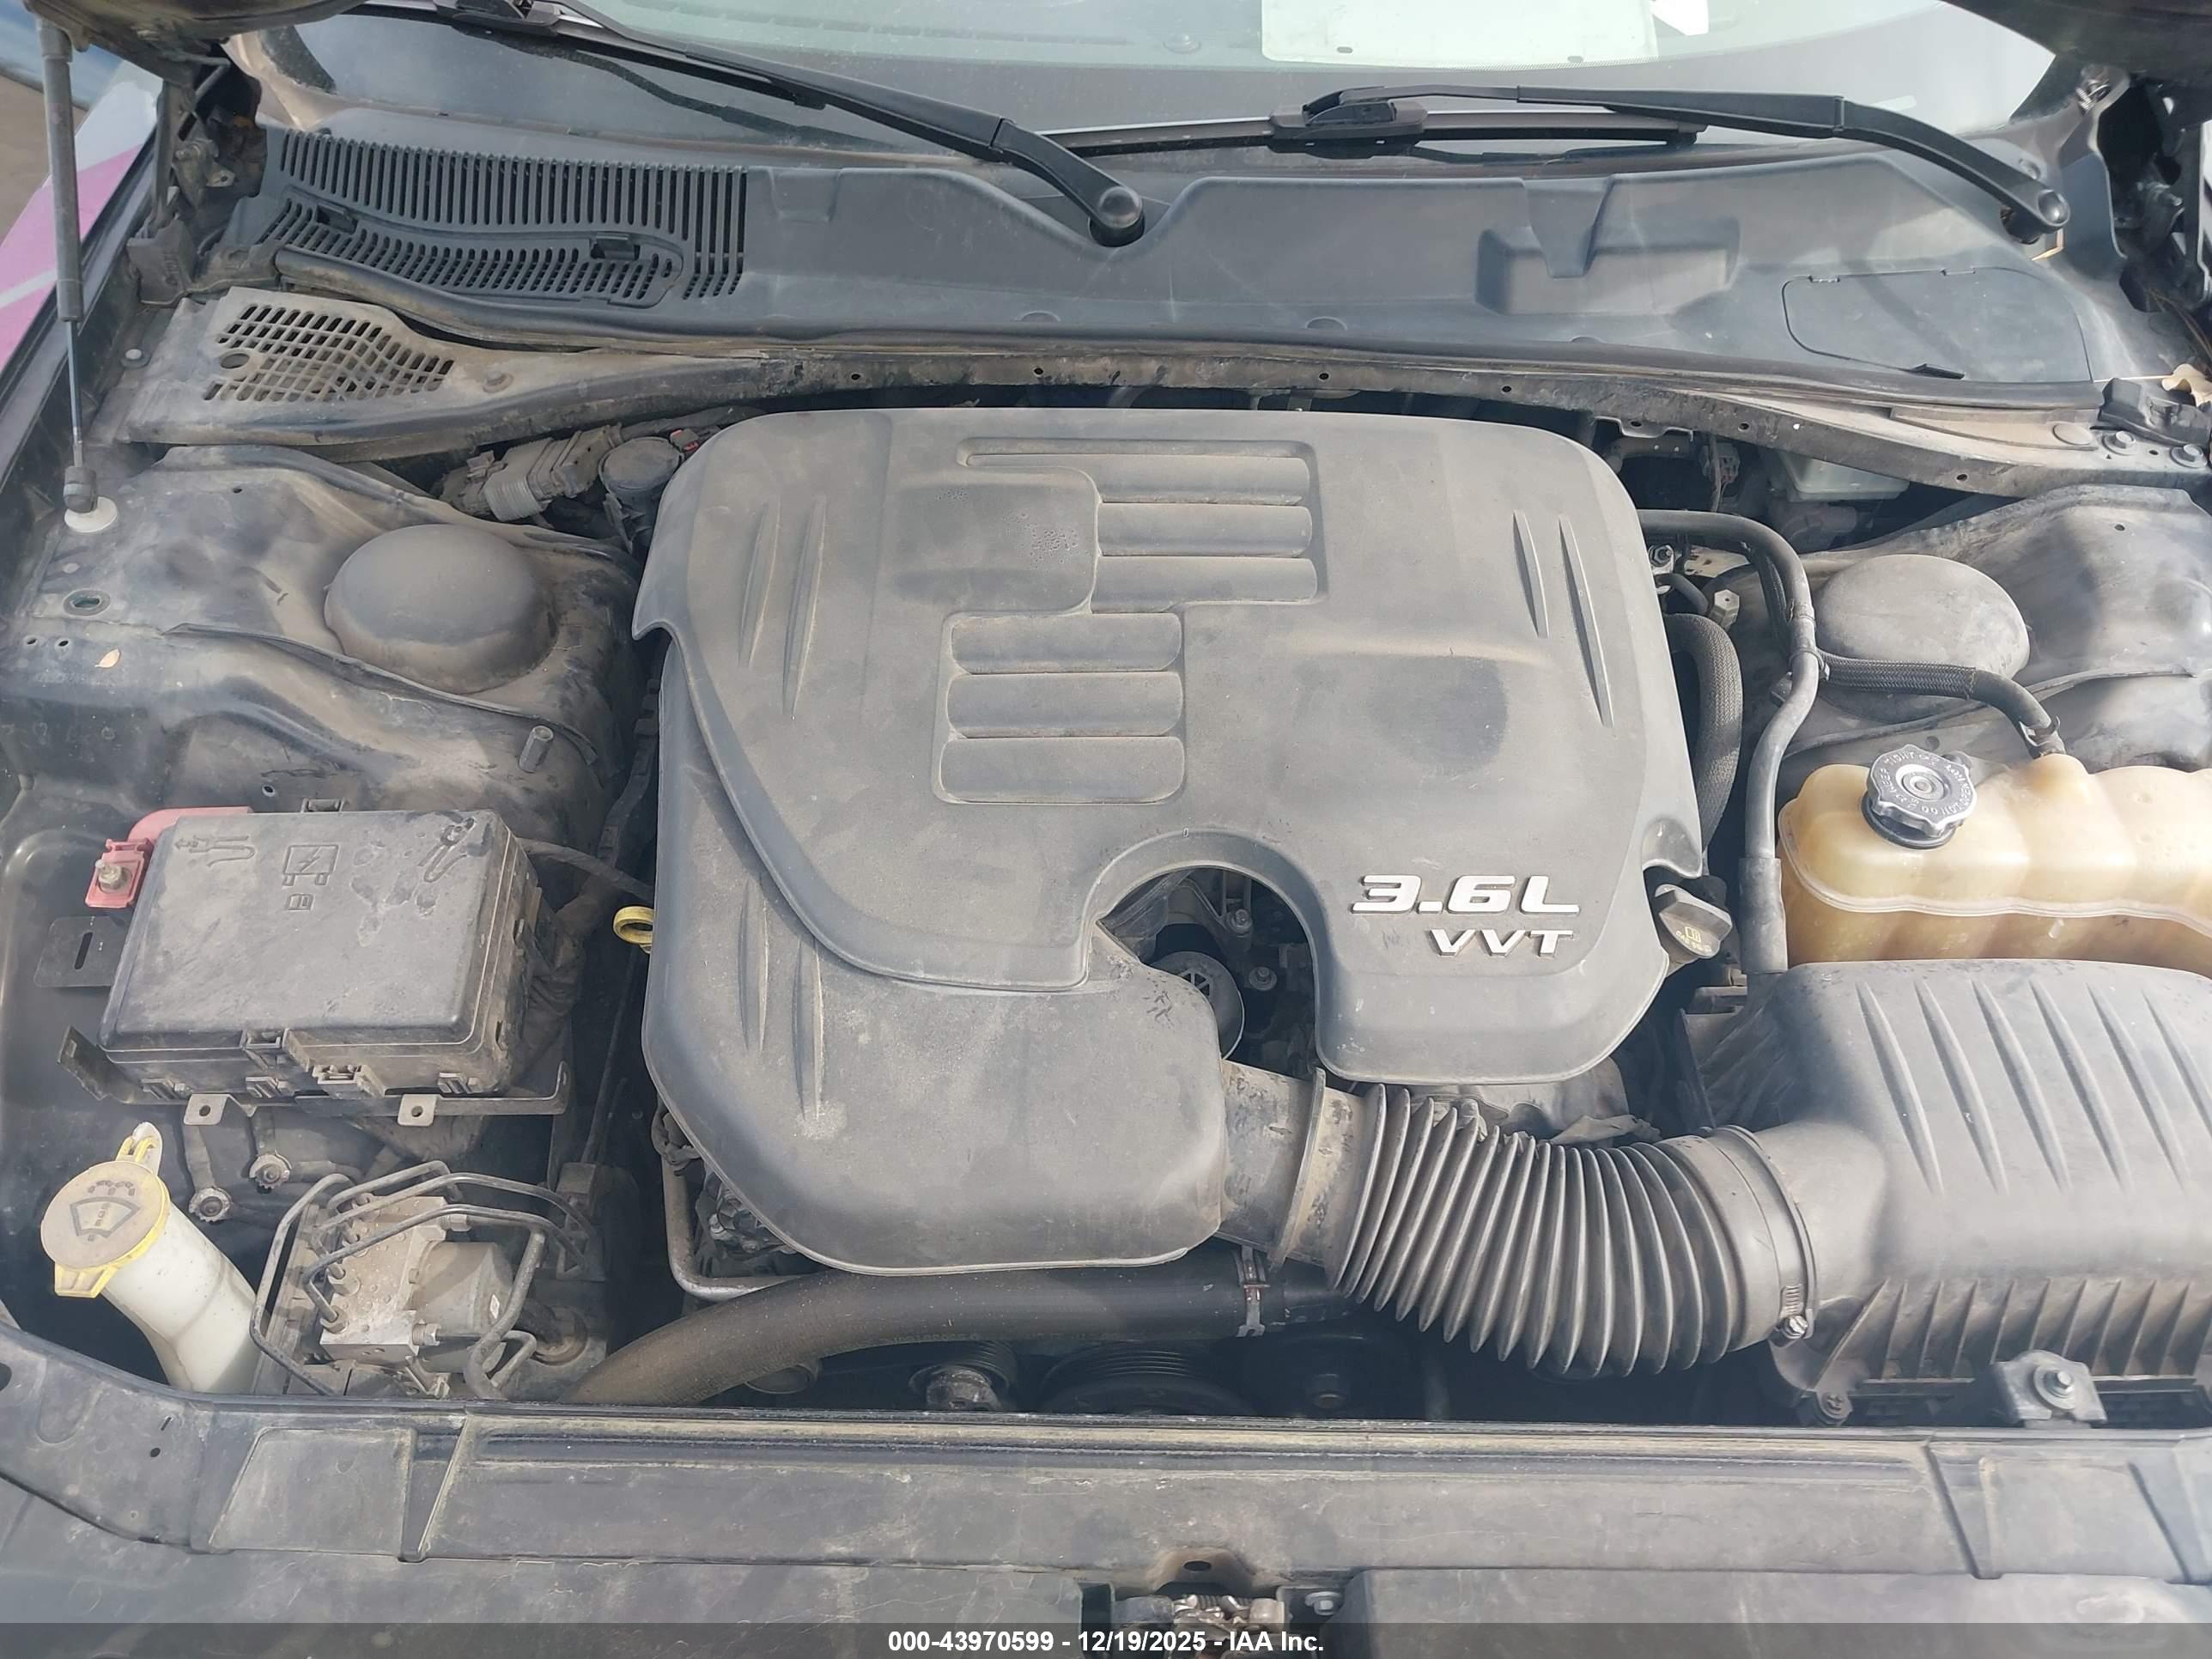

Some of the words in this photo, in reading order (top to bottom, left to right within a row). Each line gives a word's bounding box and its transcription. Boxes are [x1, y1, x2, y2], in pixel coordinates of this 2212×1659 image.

[1883, 751, 1914, 765] TIGHT
[1350, 874, 1581, 914] 3.6L
[1428, 928, 1574, 957] VVT
